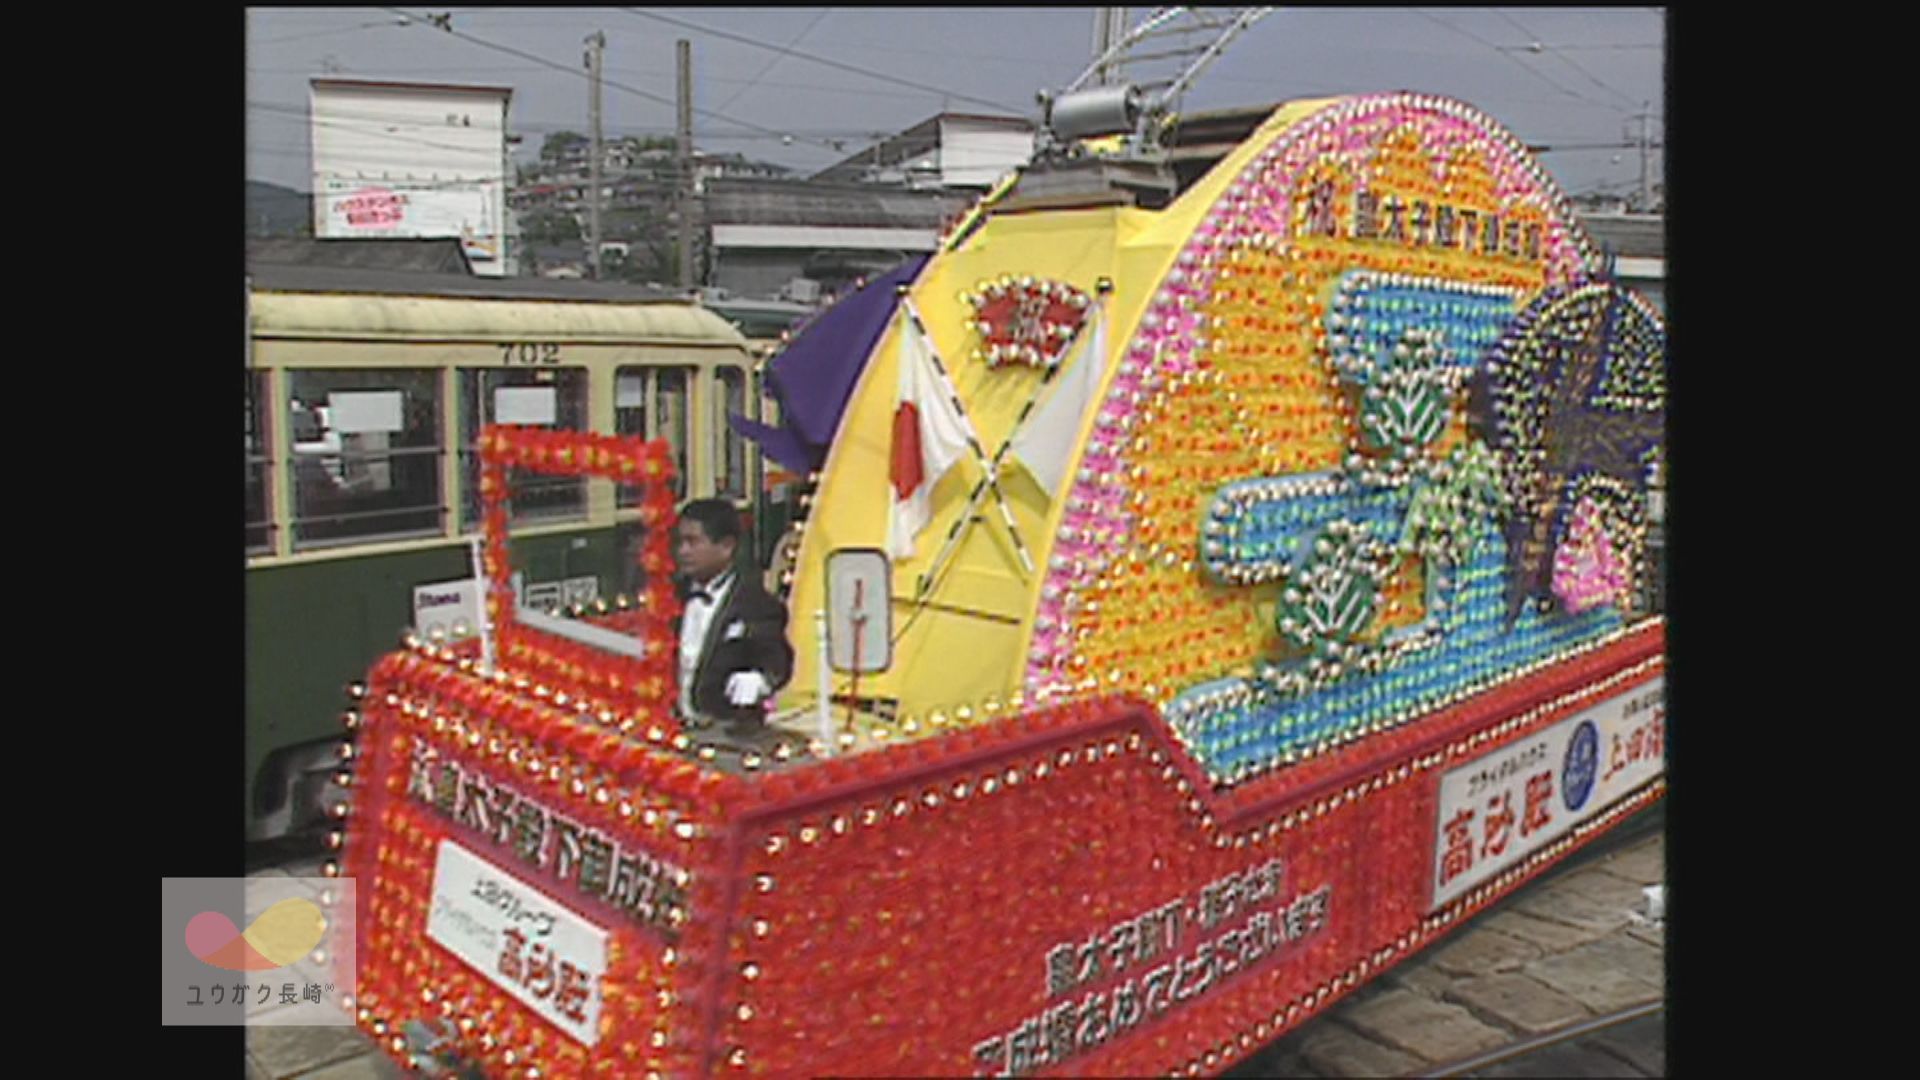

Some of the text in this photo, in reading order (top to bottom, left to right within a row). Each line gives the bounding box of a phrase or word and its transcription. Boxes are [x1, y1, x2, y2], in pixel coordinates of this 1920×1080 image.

[496, 341, 560, 368] 702
[1439, 768, 1553, 886] 高砂殿
[498, 928, 589, 1025] 高砂殿
